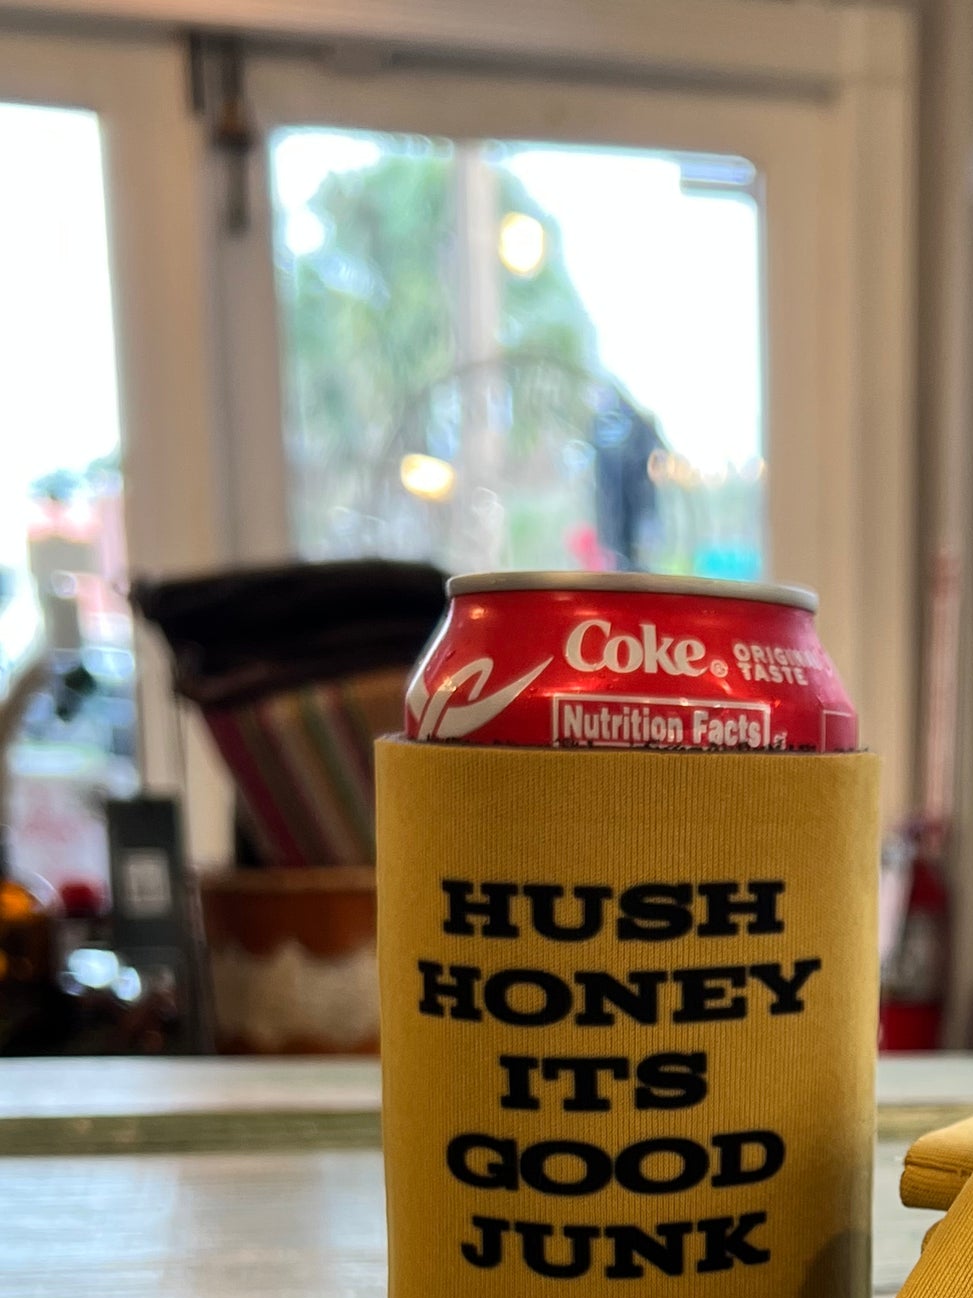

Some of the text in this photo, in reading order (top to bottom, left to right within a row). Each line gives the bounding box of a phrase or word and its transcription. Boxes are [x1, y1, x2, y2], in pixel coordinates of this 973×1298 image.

[565, 619, 709, 677] Coke
[737, 661, 809, 686] TASTE
[563, 704, 684, 743] Nutrition
[693, 709, 762, 748] Facts
[441, 878, 786, 943] HUSH
[417, 958, 822, 1028] HONEY
[499, 1050, 708, 1113] ITS
[446, 1130, 786, 1197] GOOD
[460, 1210, 772, 1280] JUNK
